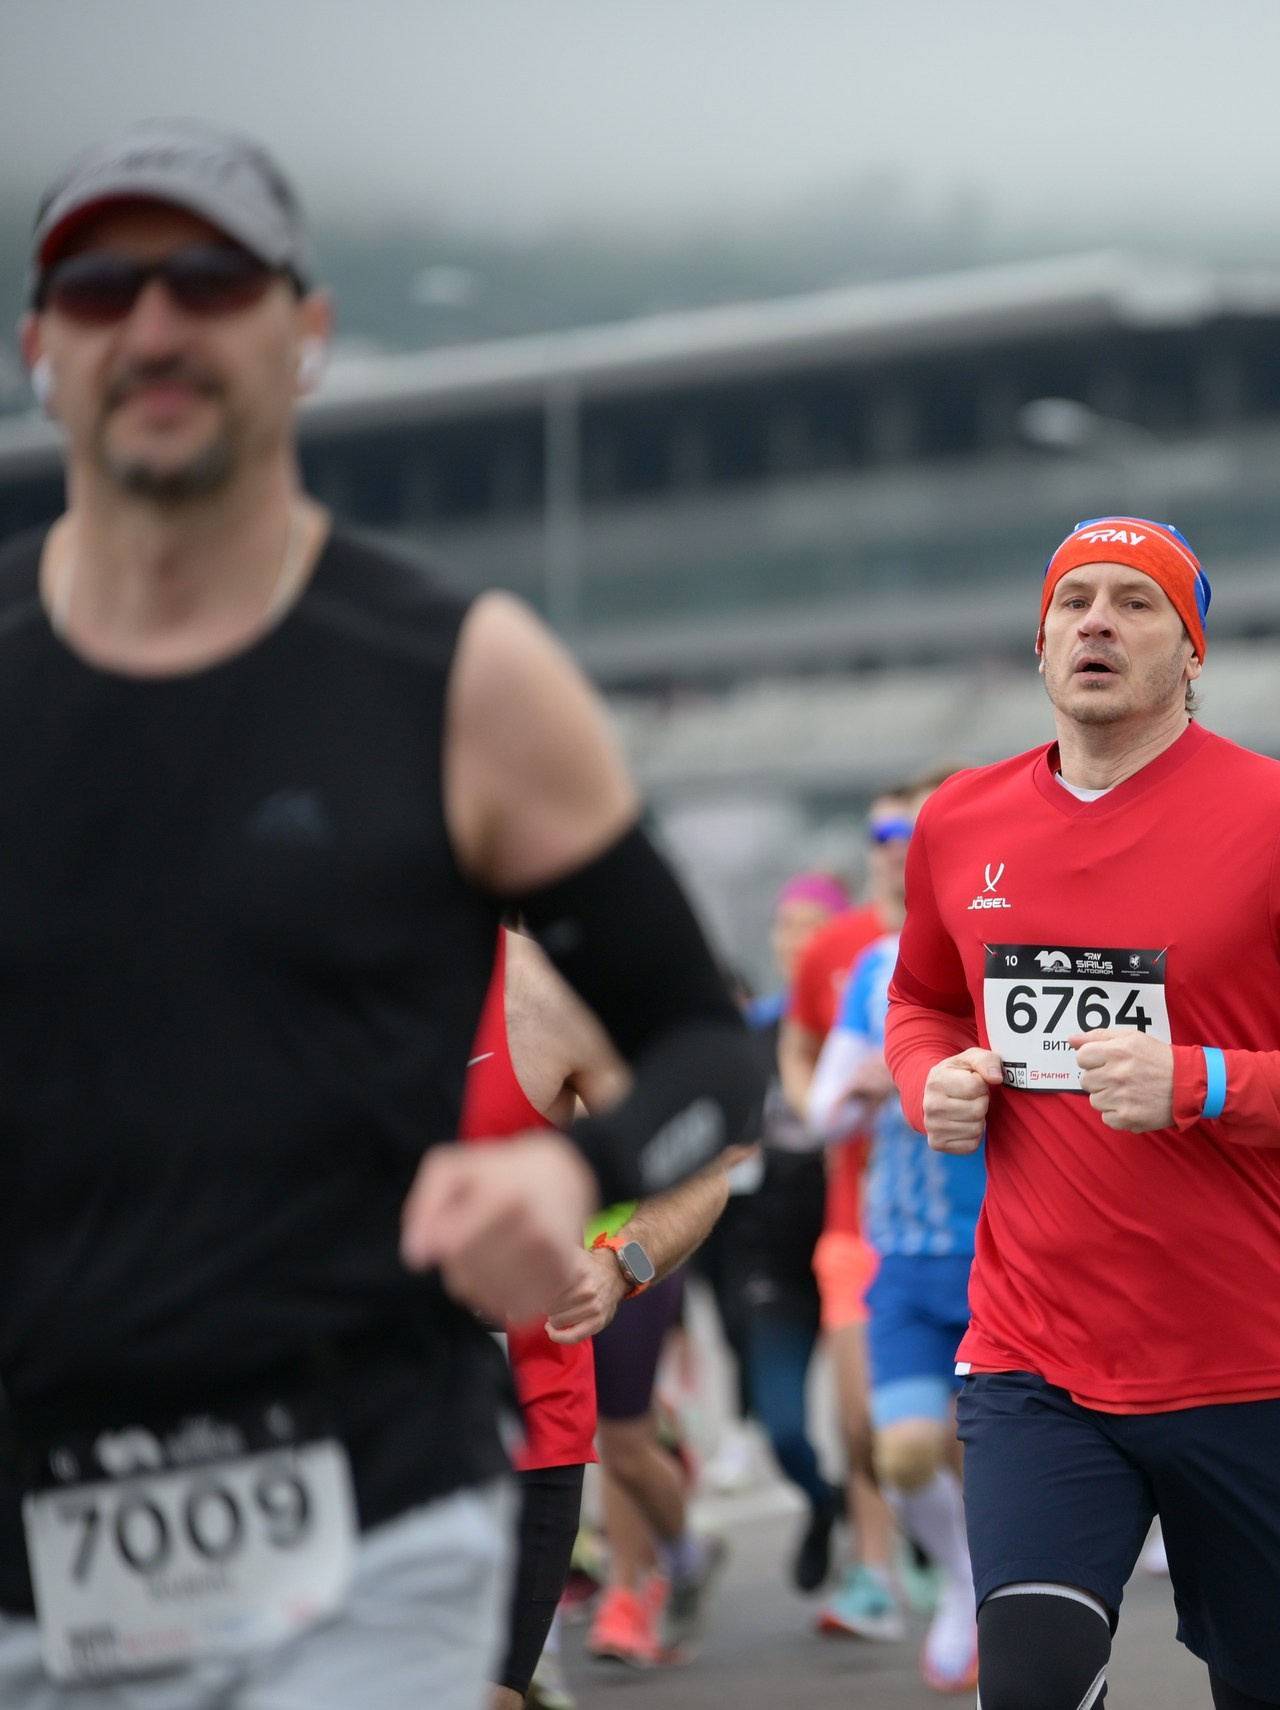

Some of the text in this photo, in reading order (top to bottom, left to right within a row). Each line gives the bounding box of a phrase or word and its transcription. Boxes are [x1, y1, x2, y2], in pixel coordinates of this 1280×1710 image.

[1076, 529, 1146, 546] RAY
[967, 896, 1011, 910] JÖGEL
[1005, 955, 1018, 967] 10
[1076, 960, 1113, 970] SIRIUS
[1005, 985, 1152, 1034] 6764
[55, 1467, 312, 1586] 7009
